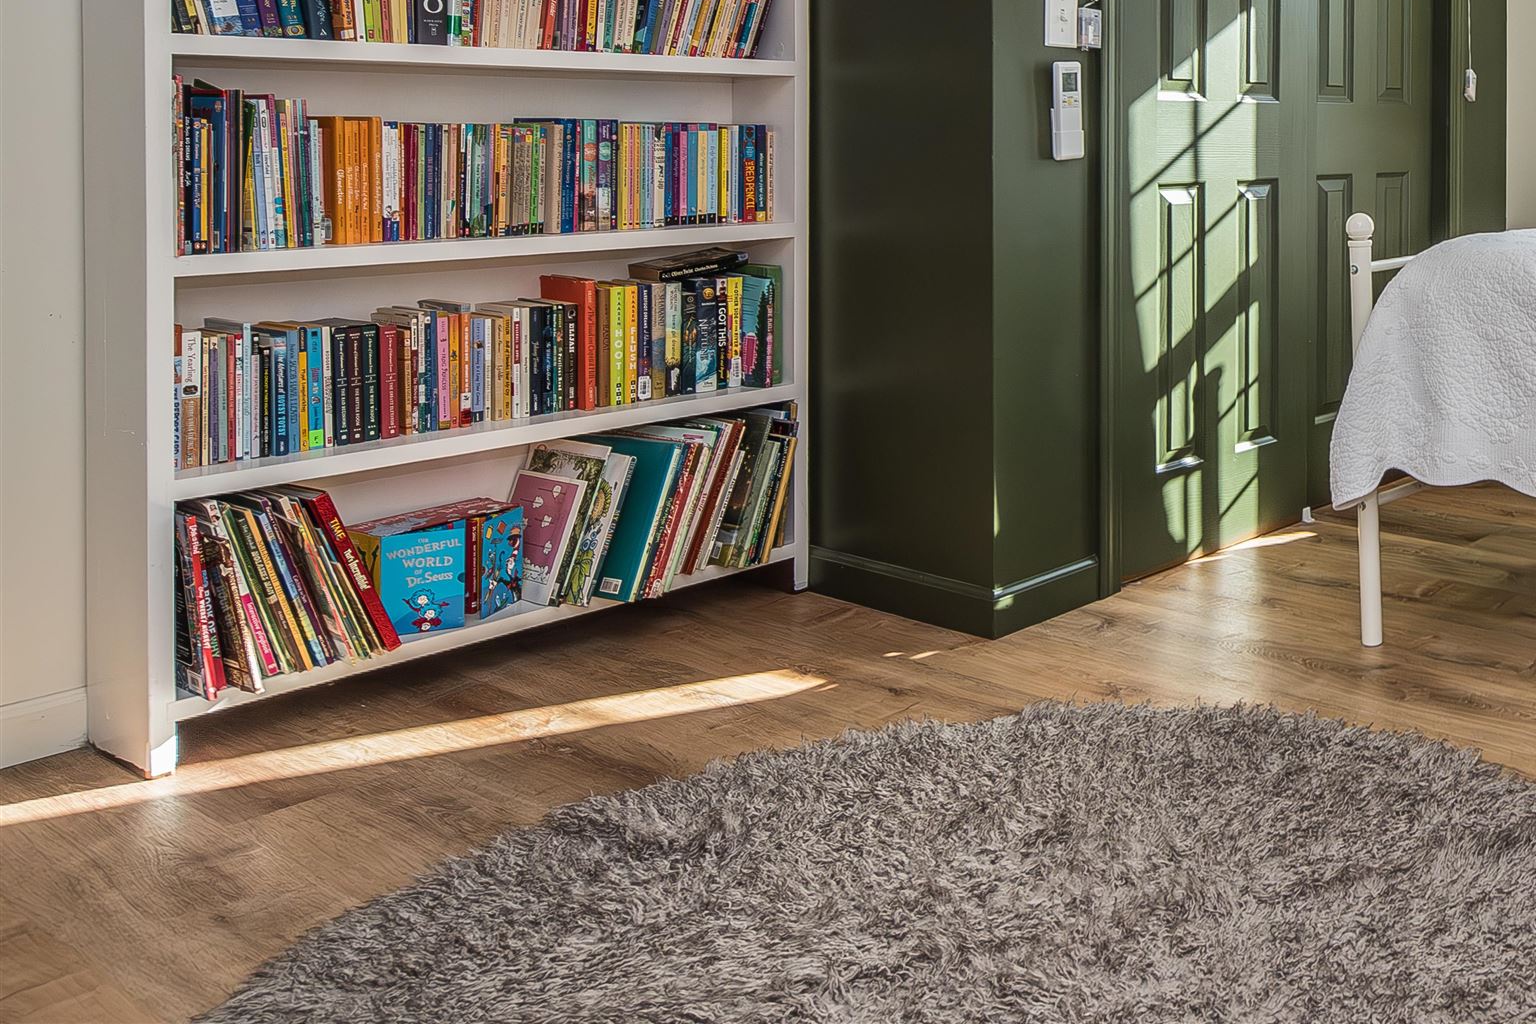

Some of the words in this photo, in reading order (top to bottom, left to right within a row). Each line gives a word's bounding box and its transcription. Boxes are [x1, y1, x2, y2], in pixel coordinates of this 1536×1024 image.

[745, 166, 754, 182] RED
[745, 182, 754, 209] PENCIL
[718, 307, 726, 327] GOT
[187, 337, 195, 351] The
[185, 353, 195, 382] Yearling
[328, 517, 346, 540] TIME
[386, 538, 462, 560] WONDERFUL
[402, 556, 454, 568] WORLD
[202, 590, 213, 617] BOOK
[207, 620, 216, 633] OF
[209, 635, 220, 657] WHY
